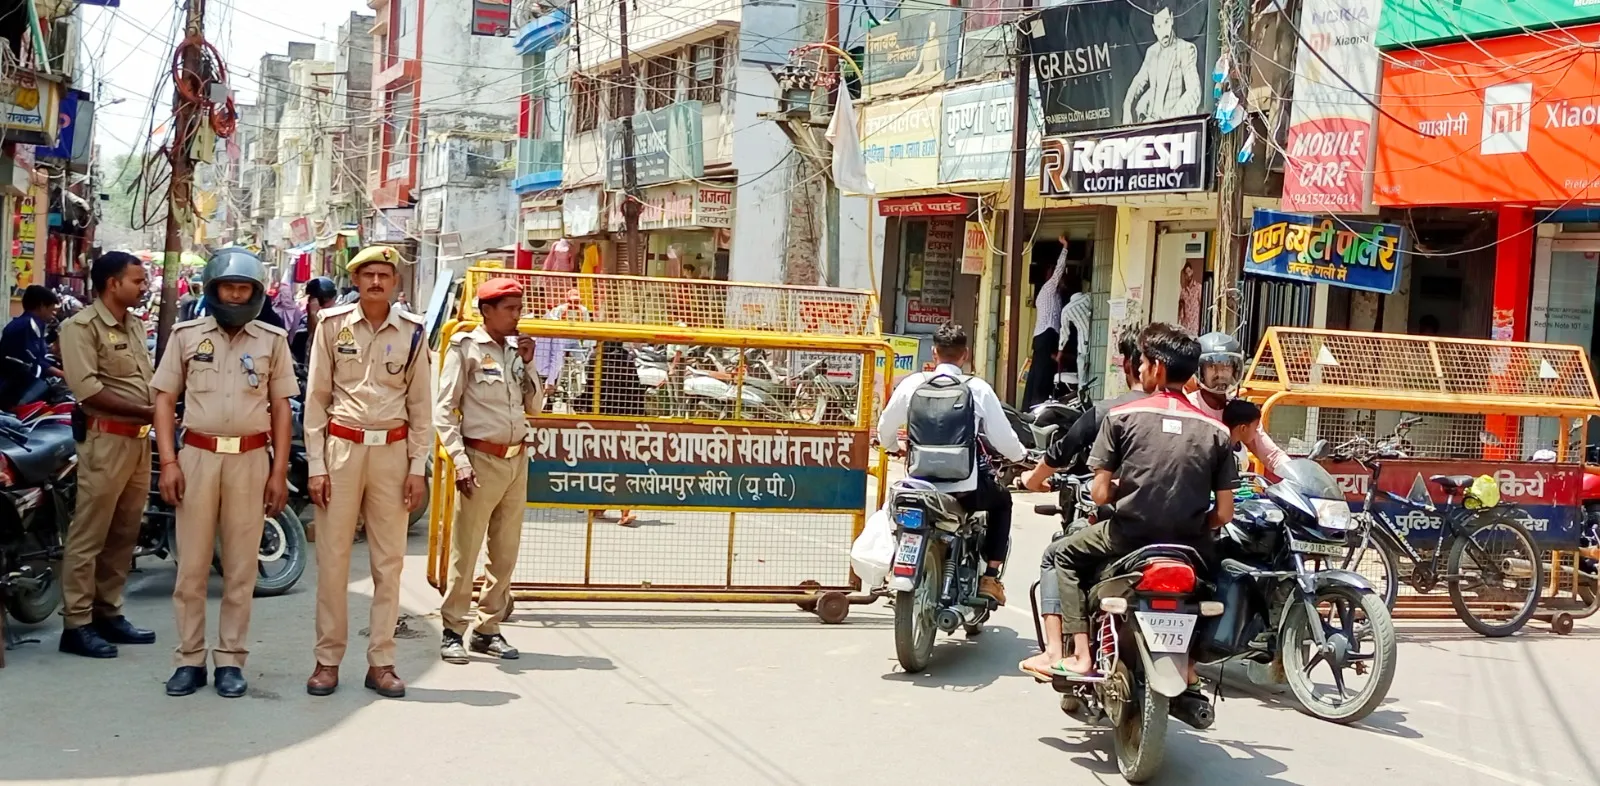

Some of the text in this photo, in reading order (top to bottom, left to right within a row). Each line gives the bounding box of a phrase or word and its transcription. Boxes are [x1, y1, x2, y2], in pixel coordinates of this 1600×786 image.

[1312, 7, 1369, 25] NOKIA
[1335, 34, 1369, 46] Xiaomi
[1038, 42, 1111, 79] GRASIM
[946, 97, 1015, 147] कृष्णा ग्ला
[1045, 107, 1111, 126] RAMESH CLOTH AGENCIES
[1418, 112, 1470, 138] शाओमी
[1545, 101, 1600, 129] Xiao
[1072, 131, 1198, 174] RAMESH
[1291, 130, 1364, 157] MOBILE
[1084, 172, 1183, 192] CLOTH AGENCY
[1300, 161, 1351, 188] CARE
[1294, 194, 1356, 205] 9415722614
[1286, 219, 1336, 263] ब्यूटी
[1337, 225, 1398, 272] पार्लर
[1315, 262, 1336, 280] गली
[1337, 264, 1348, 282] में
[560, 421, 621, 467] पुलिस
[620, 424, 667, 466] सदैव
[667, 427, 736, 464] आपकी
[788, 435, 836, 467] तत्पर
[836, 431, 855, 471] हैं
[548, 471, 620, 497] जनपद
[625, 468, 697, 501] लखीमपुर
[698, 470, 733, 497] खीरी
[1153, 633, 1184, 646] 7775
